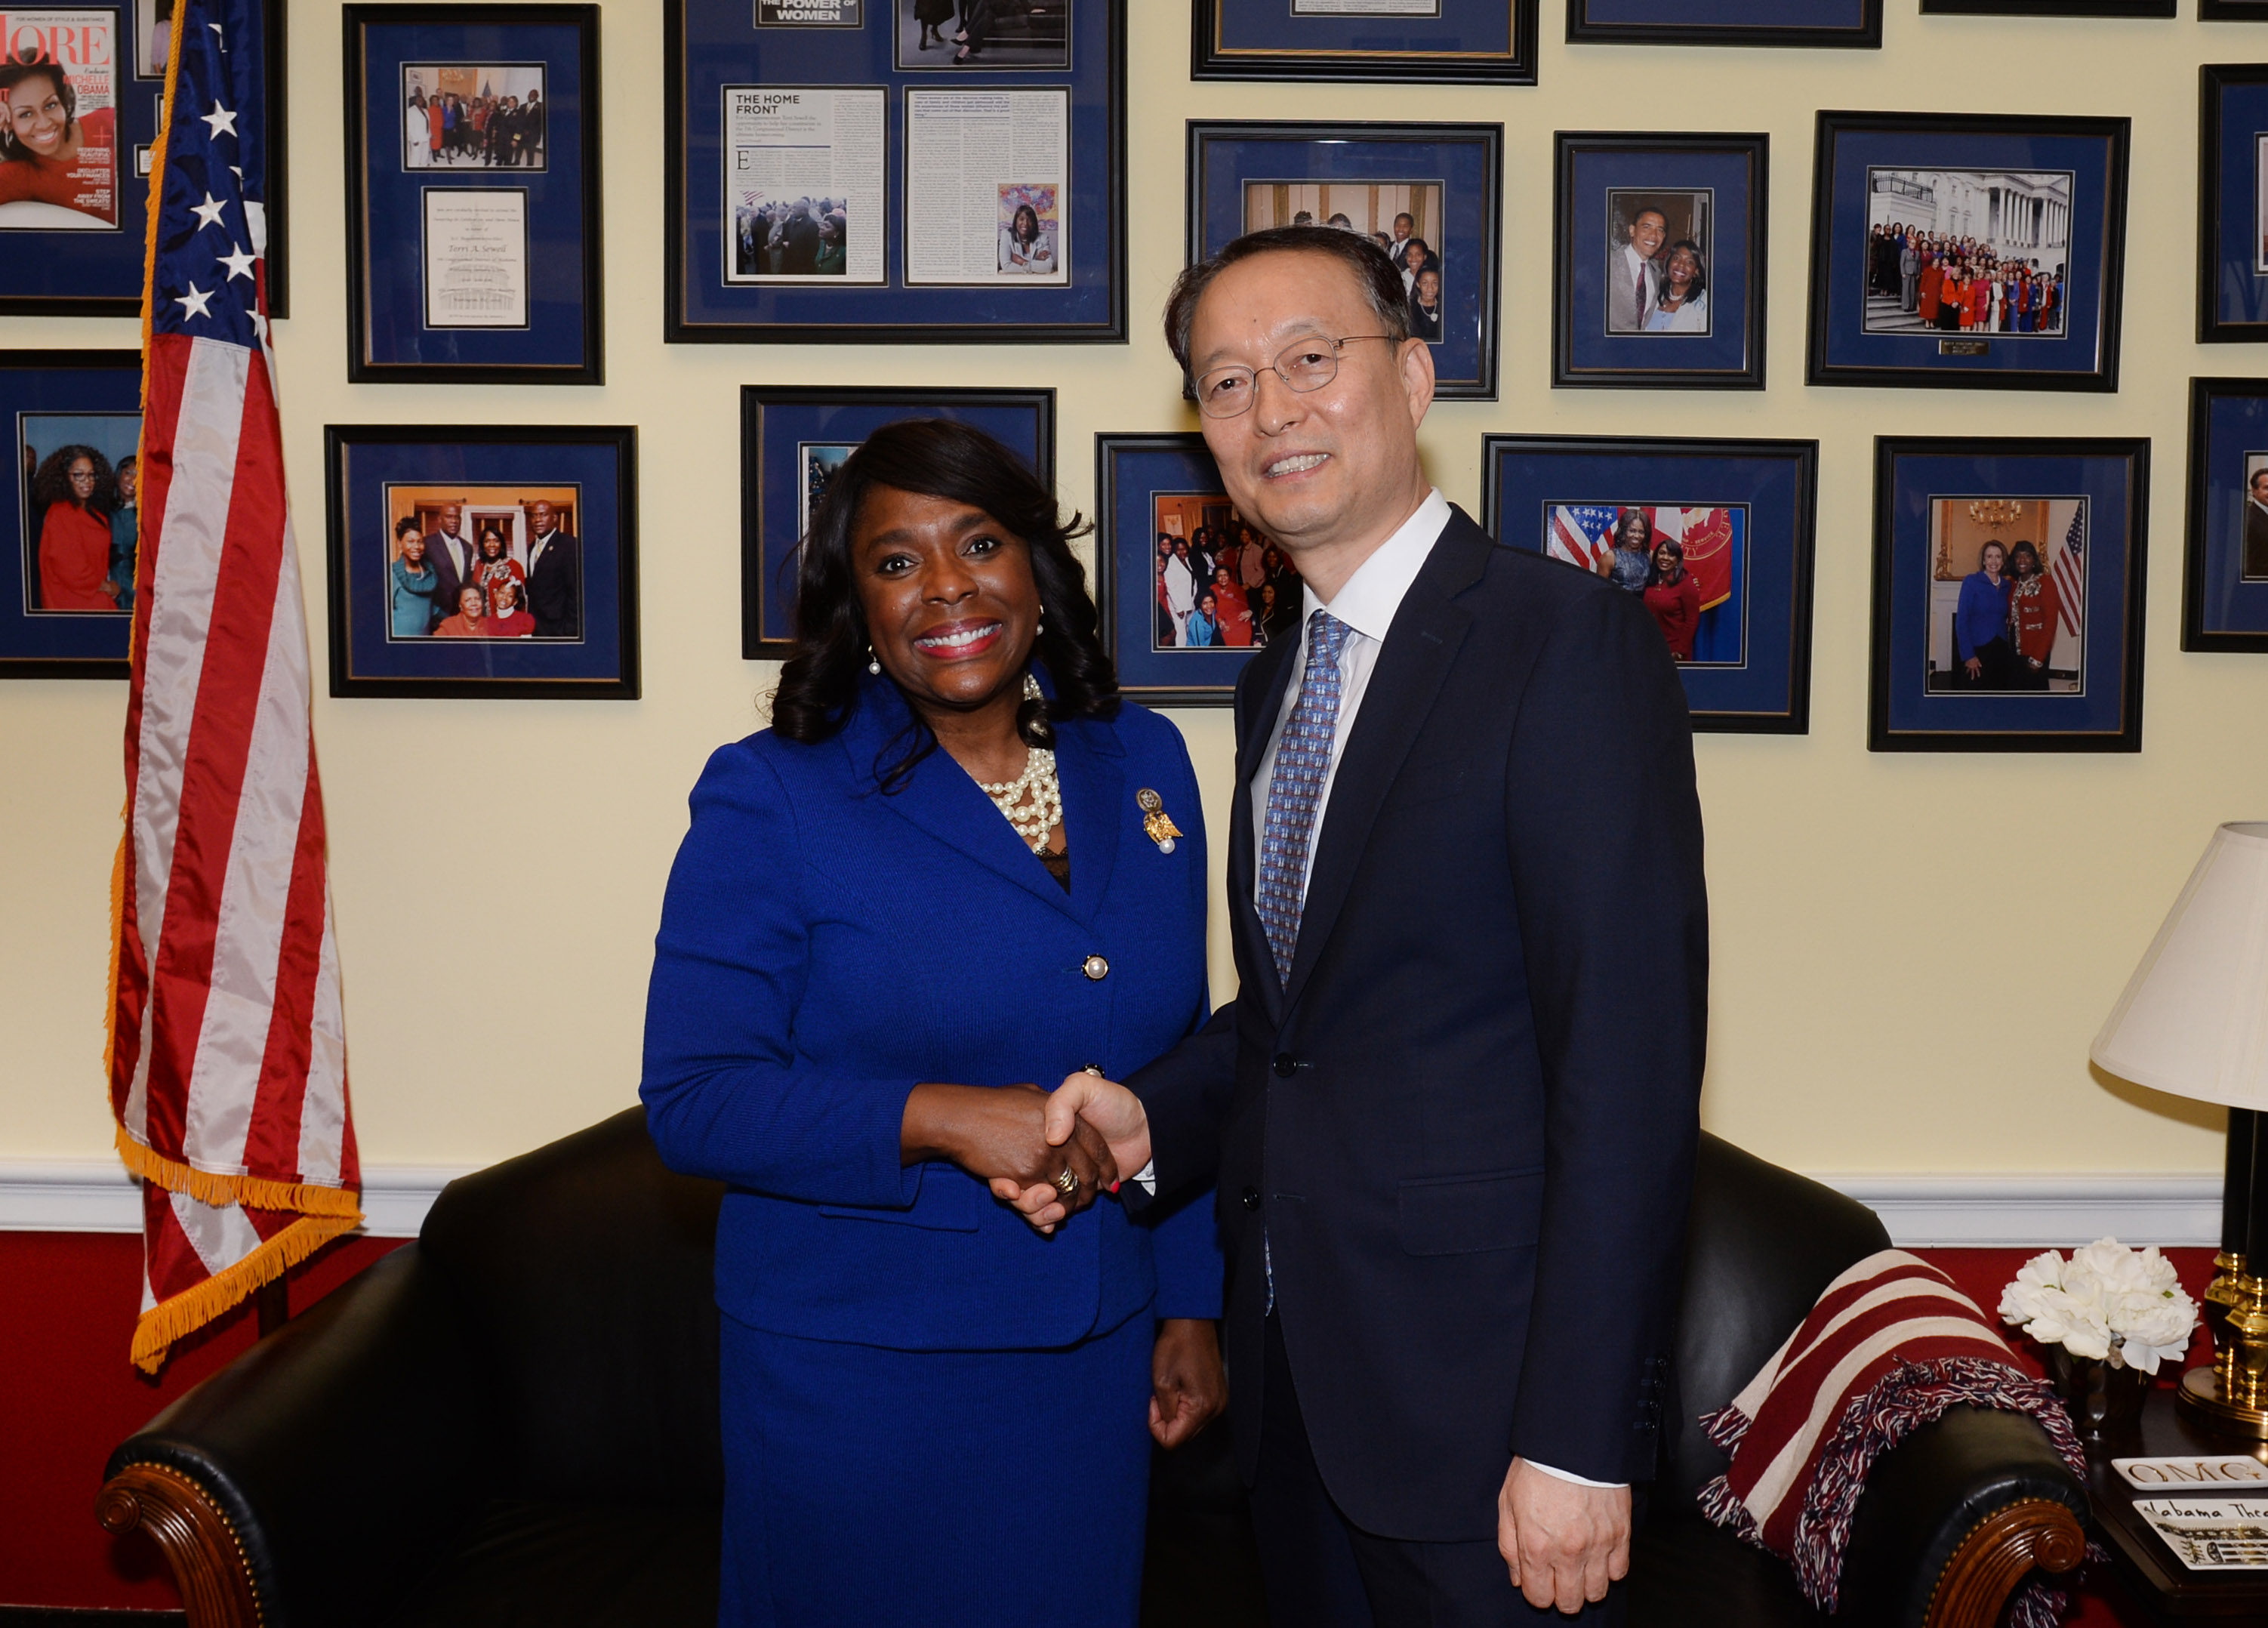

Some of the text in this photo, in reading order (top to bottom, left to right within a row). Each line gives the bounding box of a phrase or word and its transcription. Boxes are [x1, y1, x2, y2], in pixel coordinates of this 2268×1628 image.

[782, 0, 841, 8] POWER
[776, 10, 840, 20] WOMEN
[63, 75, 109, 85] MICHELLE
[77, 85, 110, 94] OBAMA
[736, 94, 800, 104] THE HOME
[736, 105, 778, 115] FRONT
